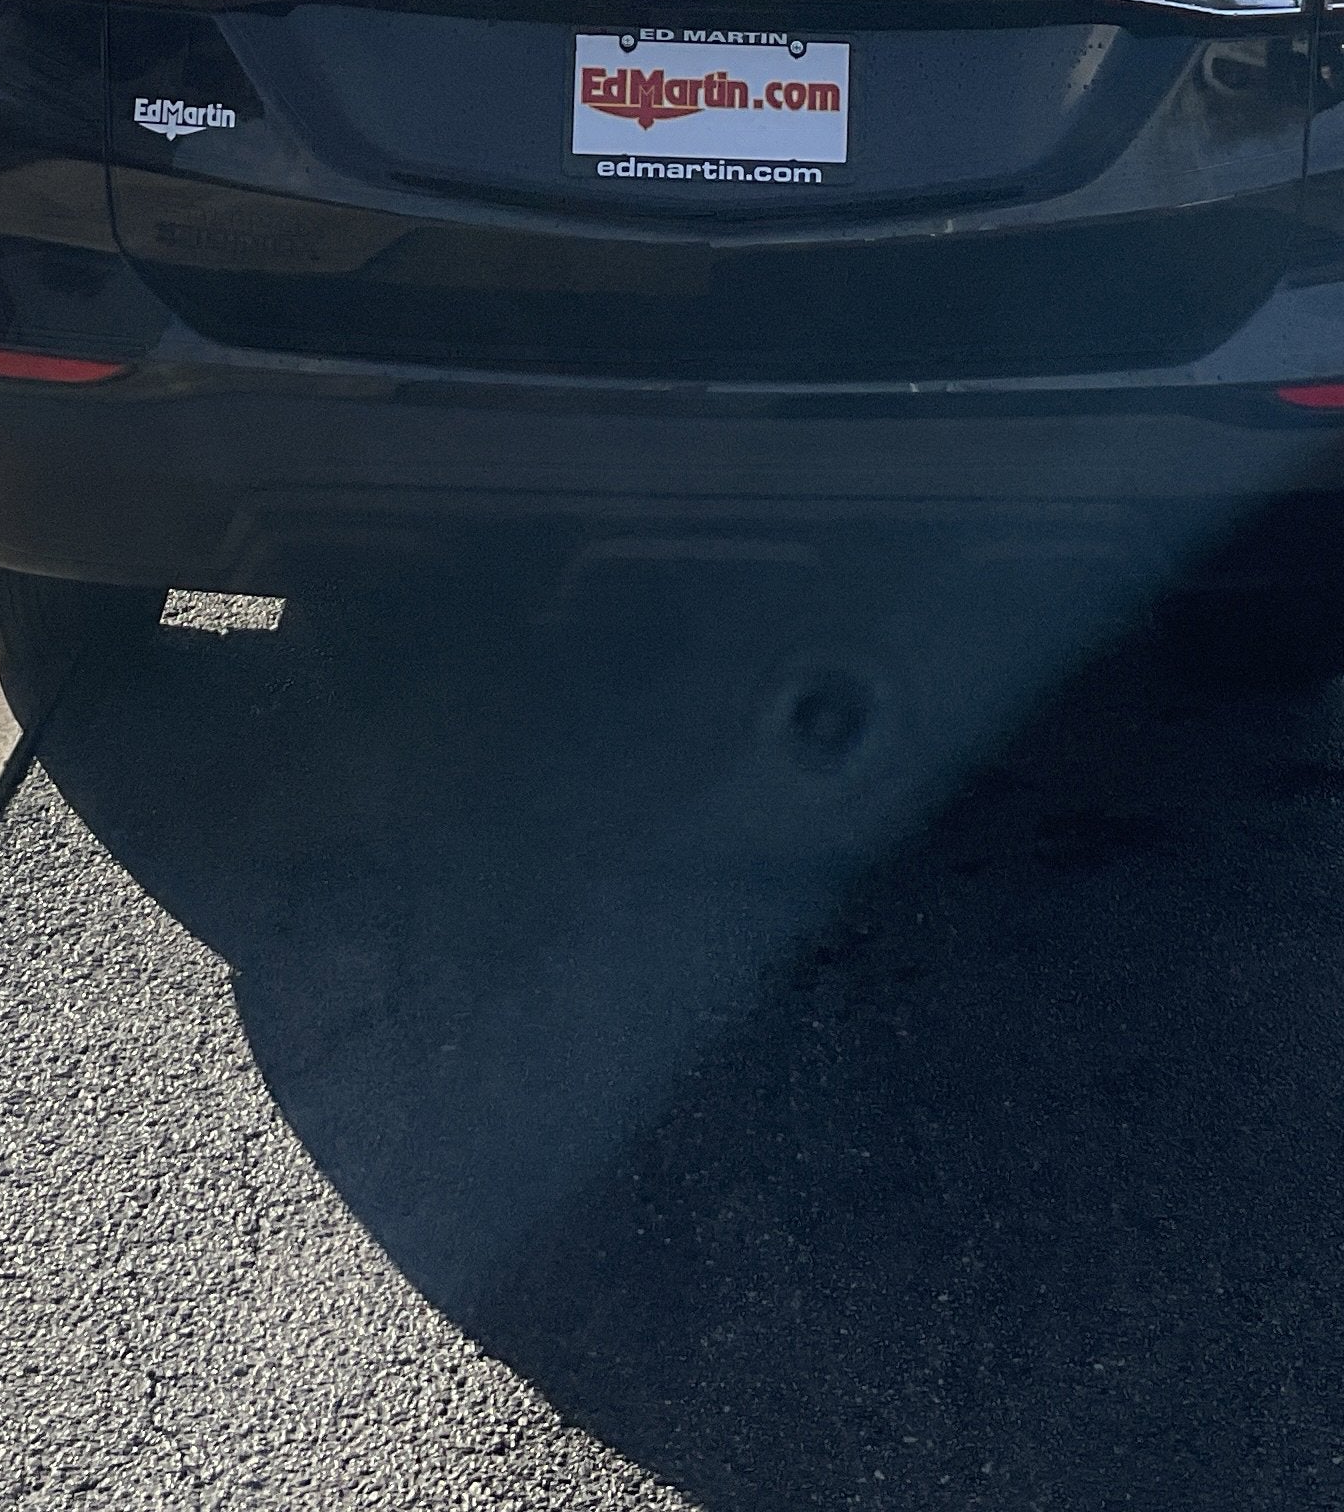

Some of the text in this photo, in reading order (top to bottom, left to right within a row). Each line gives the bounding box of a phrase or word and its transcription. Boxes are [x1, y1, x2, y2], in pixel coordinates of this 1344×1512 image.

[640, 28, 788, 45] ED MARTIN
[581, 67, 841, 112] EdMartin.com
[133, 98, 236, 129] EdMartin
[596, 157, 822, 184] edmartin.com
